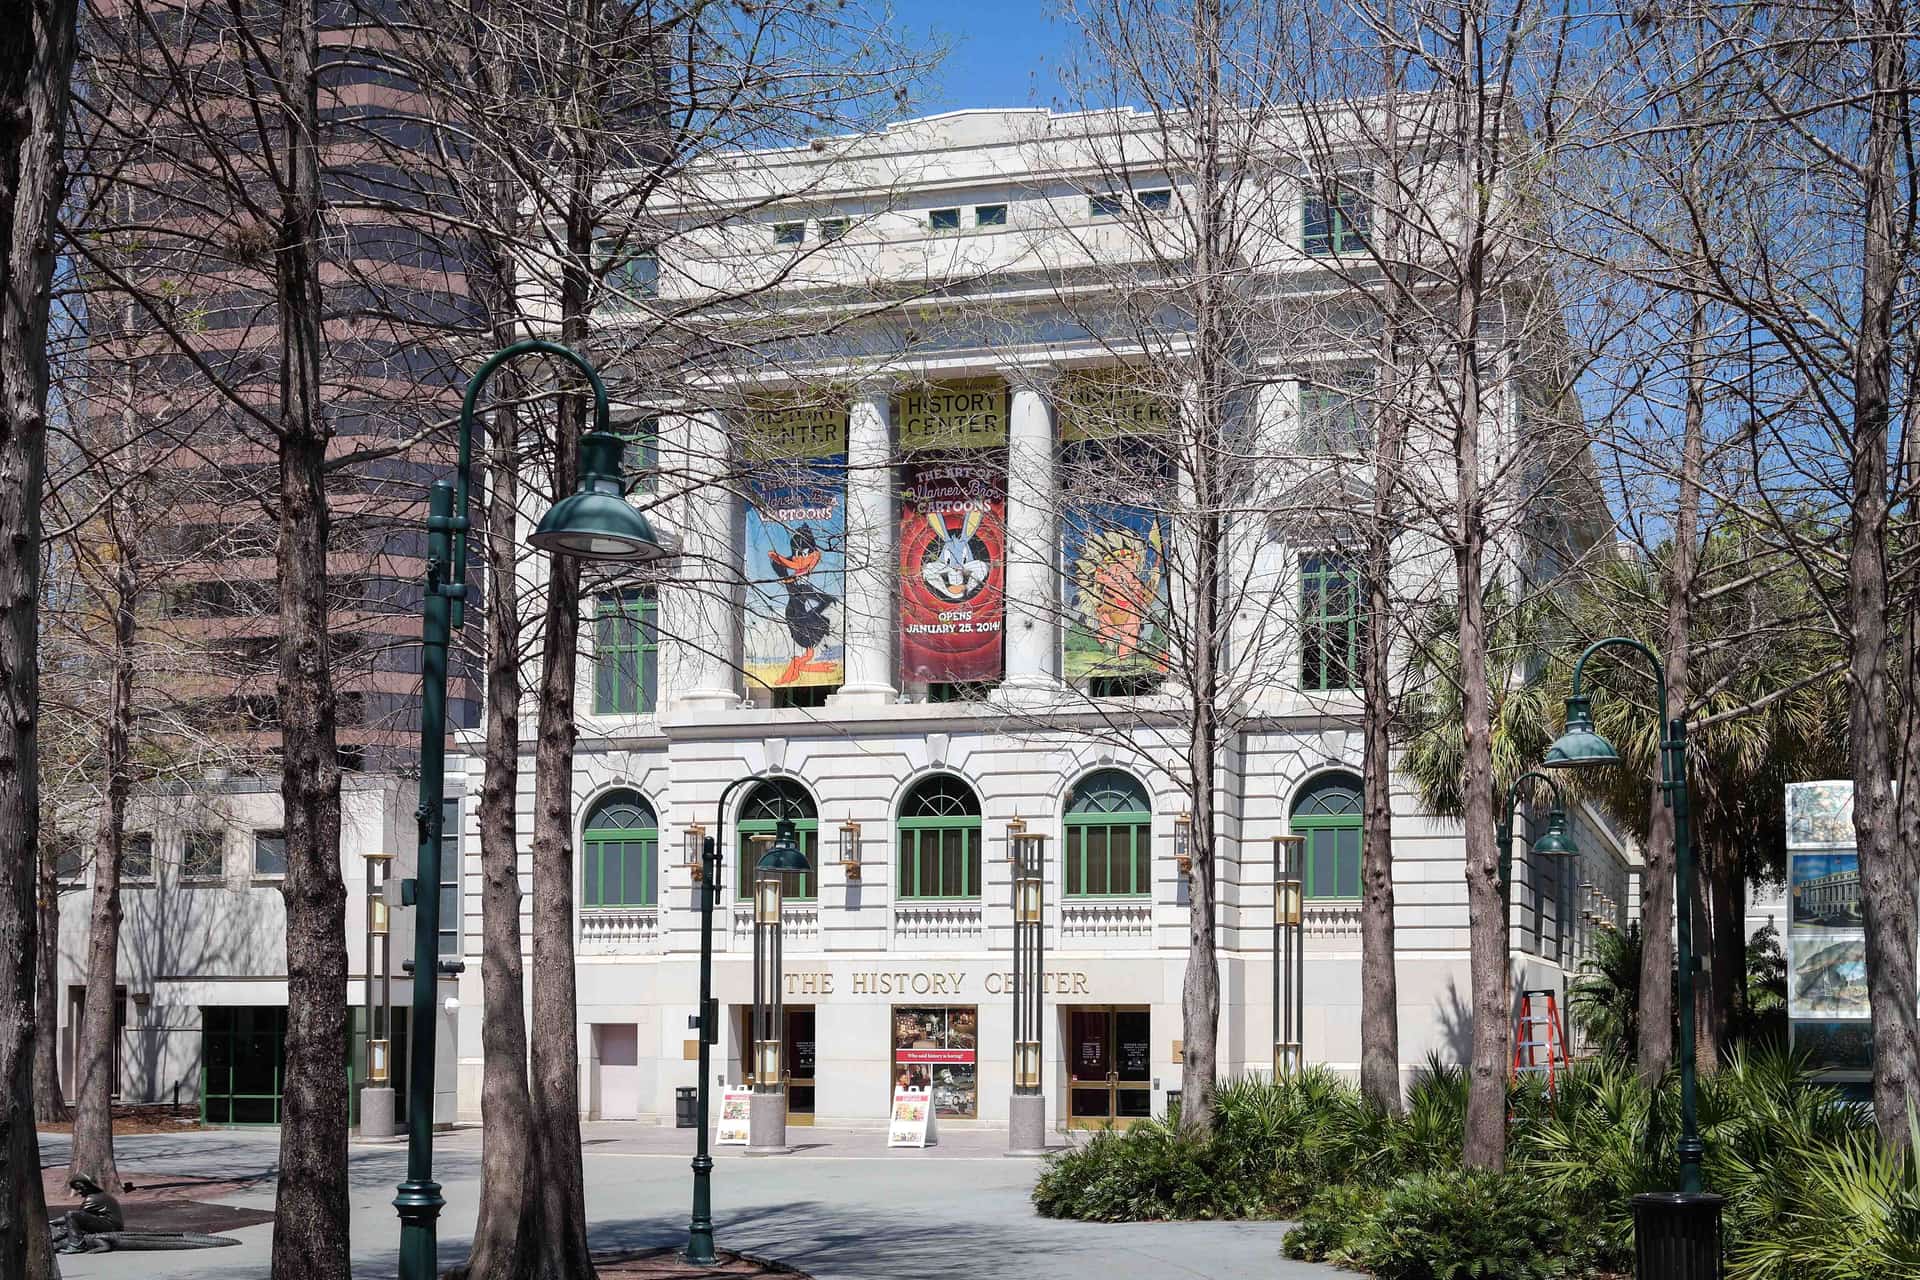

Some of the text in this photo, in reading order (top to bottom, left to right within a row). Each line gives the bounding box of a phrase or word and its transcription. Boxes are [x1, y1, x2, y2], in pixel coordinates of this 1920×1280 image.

[908, 392, 997, 415] HISTORY
[752, 422, 838, 448] NTER
[907, 414, 998, 436] CENTER
[916, 499, 992, 514] CARTOONS
[938, 611, 972, 621] OPENS
[906, 622, 956, 634] JANUARY
[783, 971, 1091, 995] THE HISTORY CETER
